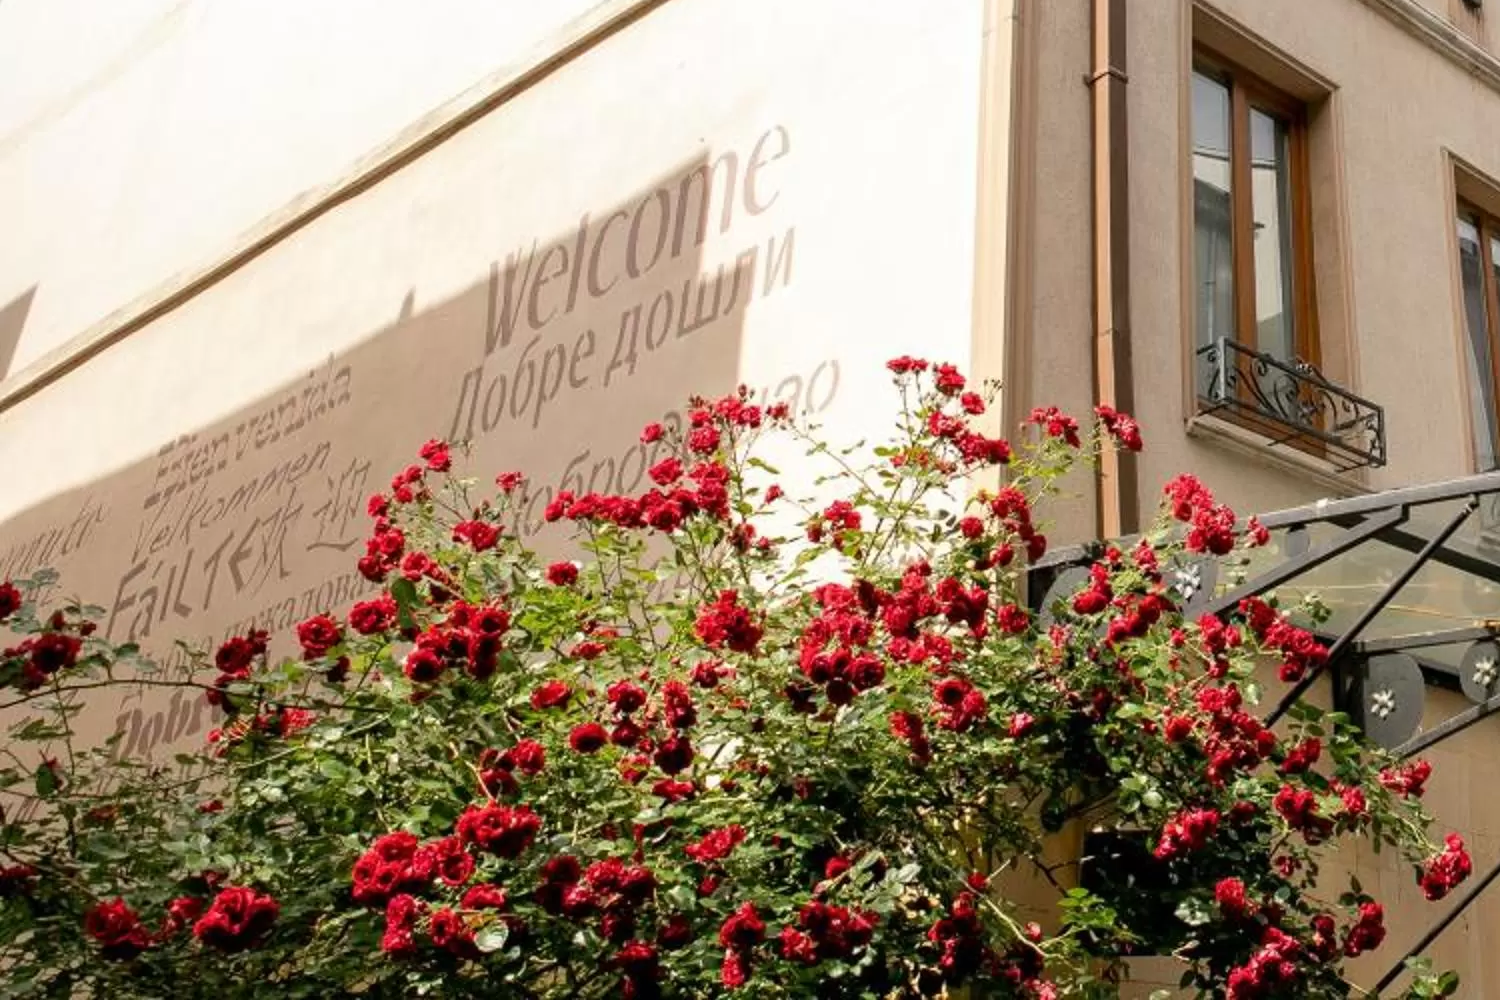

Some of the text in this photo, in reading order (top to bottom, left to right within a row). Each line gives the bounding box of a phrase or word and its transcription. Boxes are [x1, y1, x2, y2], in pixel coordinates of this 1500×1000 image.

[448, 226, 796, 445] Добре дошли
[484, 123, 791, 357] Welcome
[131, 440, 331, 564] Velkommen
